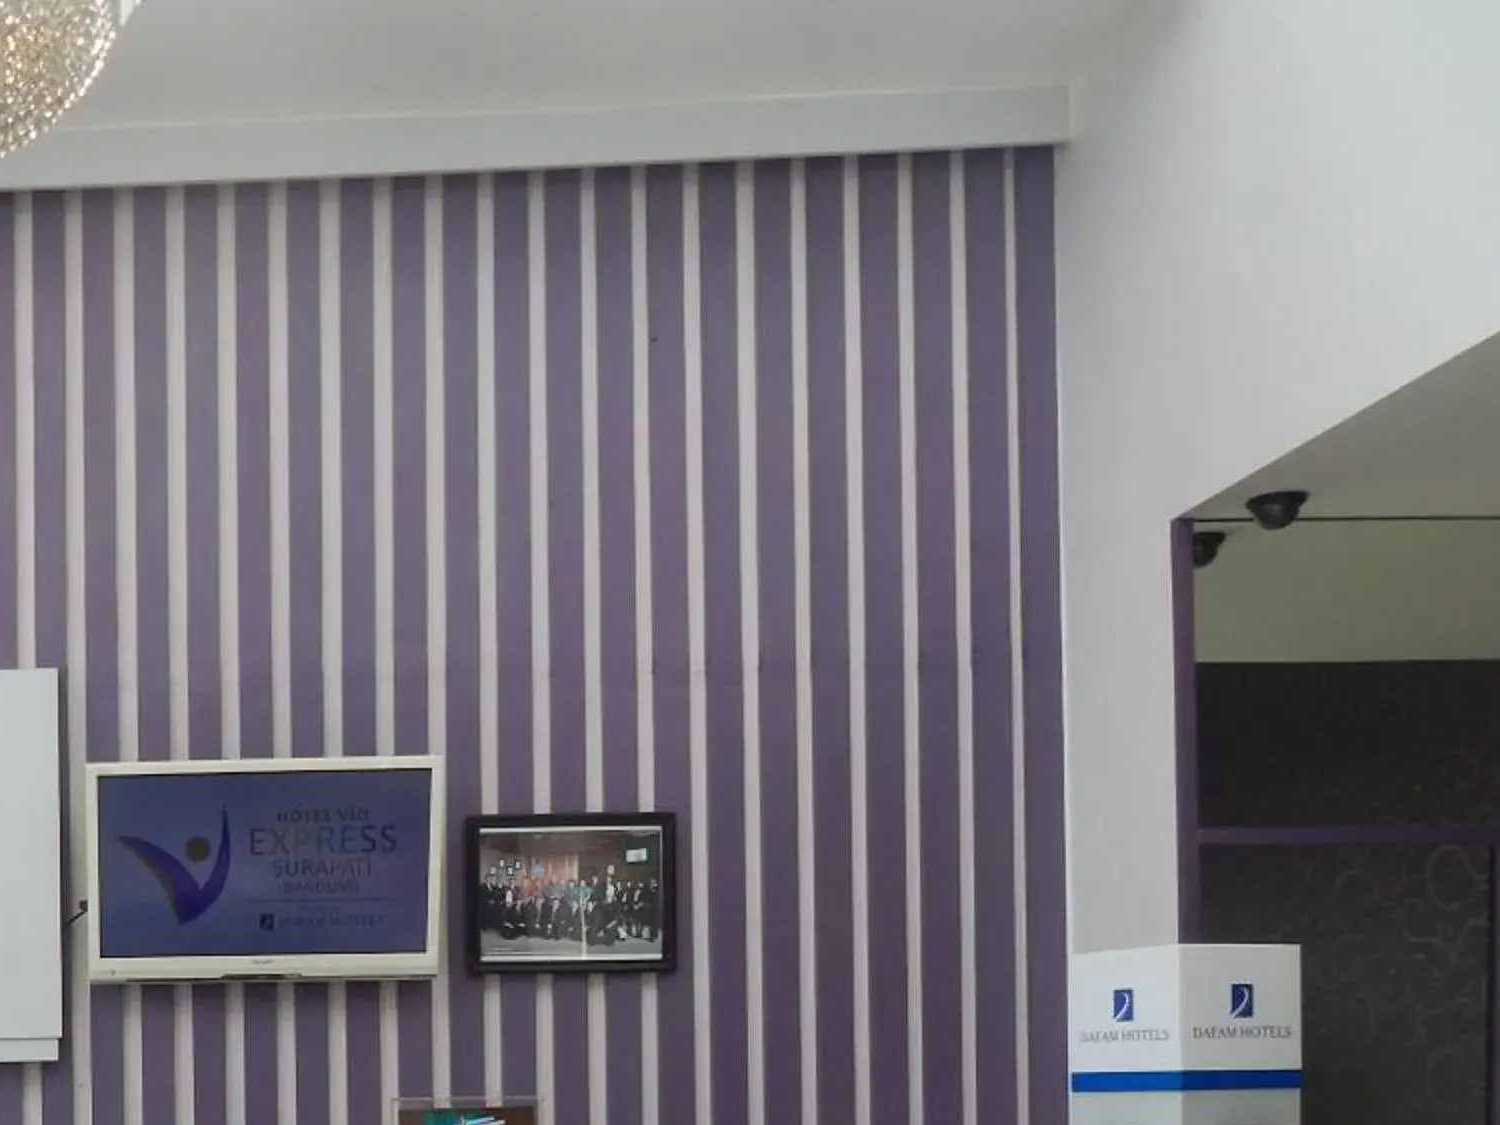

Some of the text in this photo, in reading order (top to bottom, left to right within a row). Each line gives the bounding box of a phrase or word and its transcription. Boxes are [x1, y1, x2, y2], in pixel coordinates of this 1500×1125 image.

[250, 824, 398, 856] EXPRESS
[272, 856, 372, 878] SURAPATI
[1121, 1028, 1171, 1042] HOTELS
[1240, 1025, 1293, 1040] HOTELS
